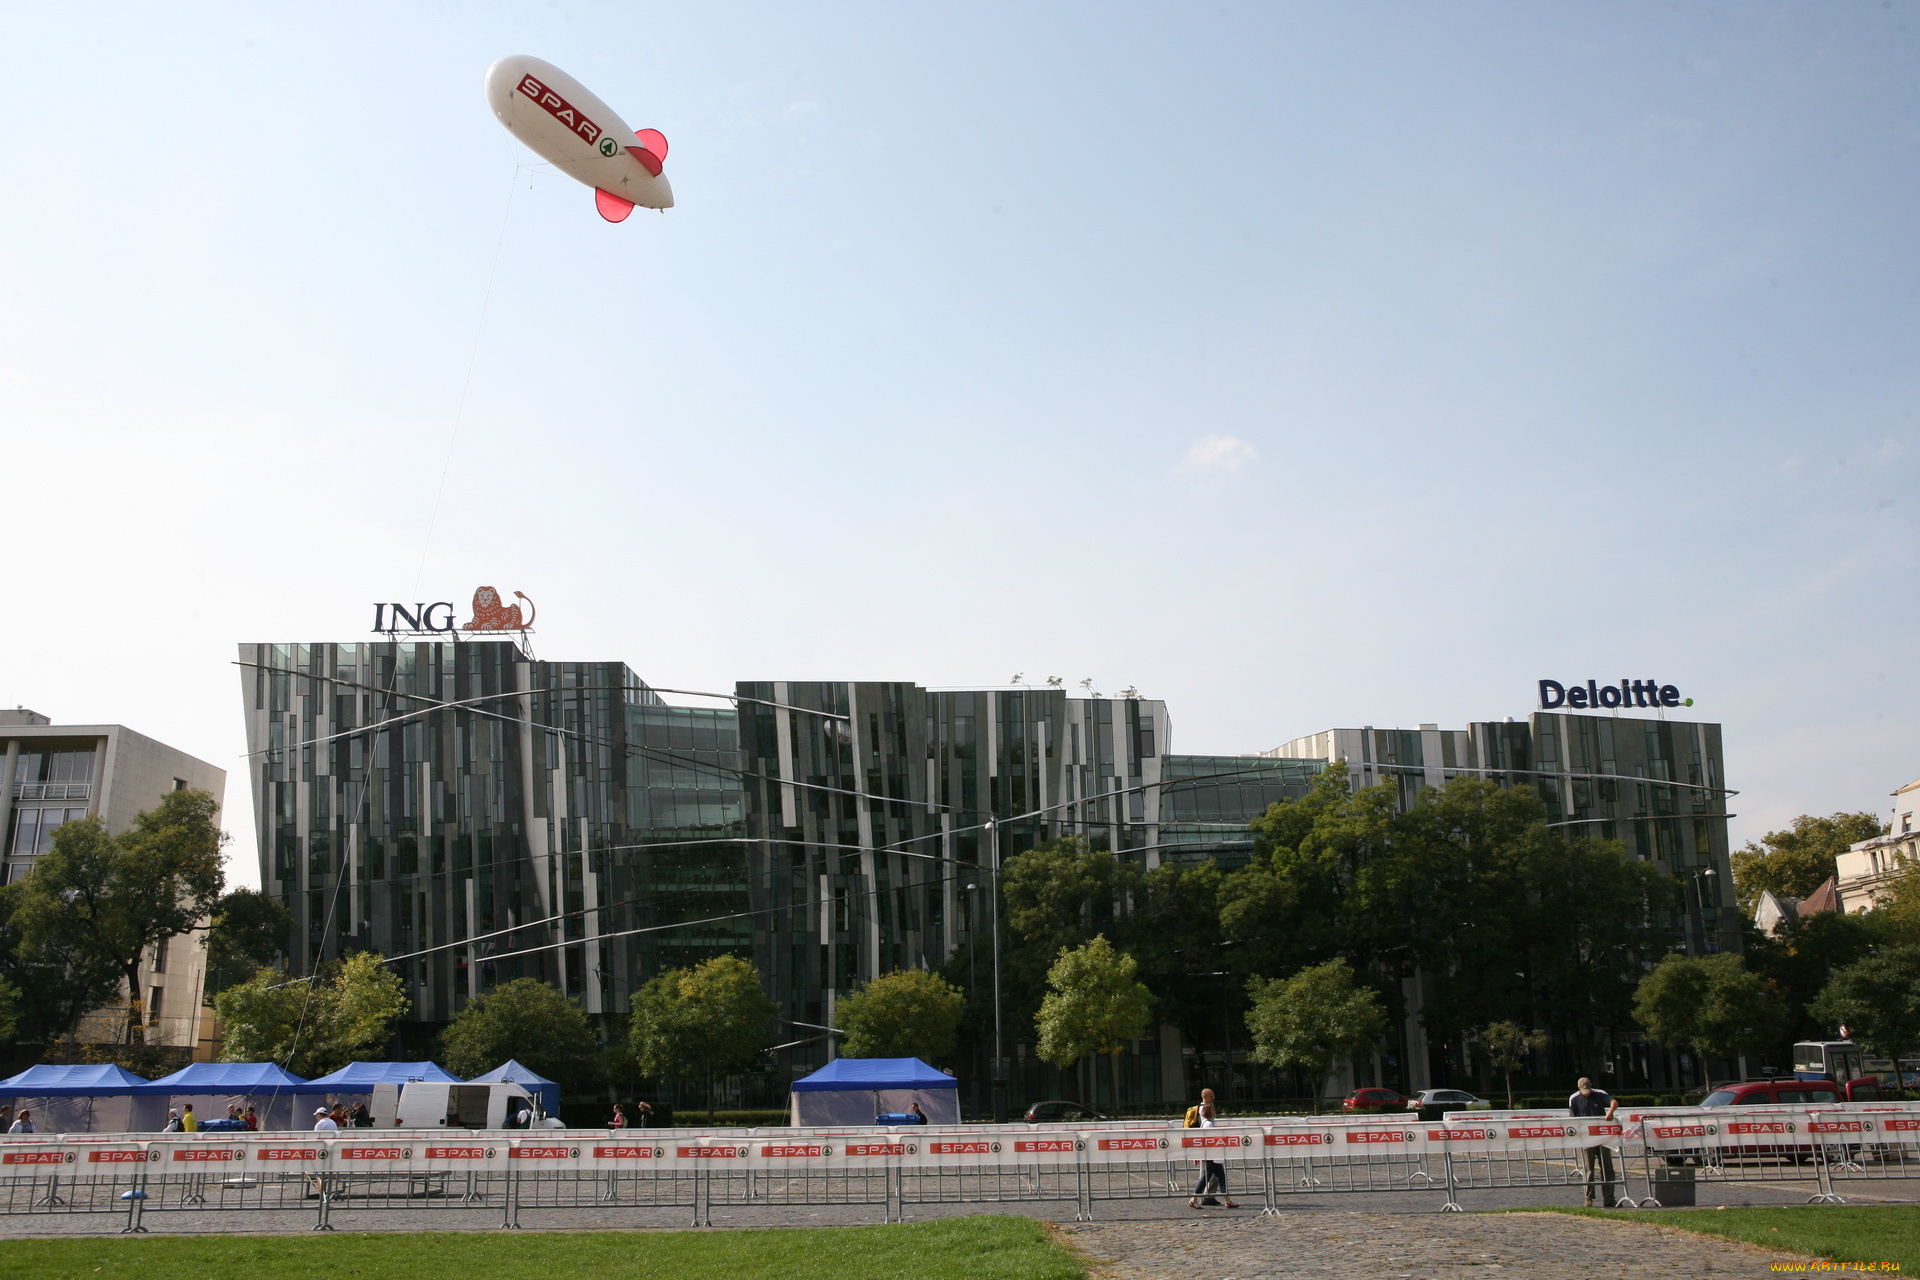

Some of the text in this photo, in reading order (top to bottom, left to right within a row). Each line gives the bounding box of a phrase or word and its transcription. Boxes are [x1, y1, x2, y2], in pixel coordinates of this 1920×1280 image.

[522, 78, 598, 142] SPAR
[370, 602, 456, 632] ING
[1738, 1124, 1784, 1133] SPAR
[1817, 1122, 1861, 1131] SPAR
[1896, 1121, 1920, 1130] SP
[1438, 1130, 1484, 1140] SPAR
[1519, 1128, 1564, 1137] SPAR
[1660, 1126, 1704, 1137] SPAR
[1193, 1137, 1240, 1147] SPAR
[1275, 1135, 1321, 1145] SPAR
[1357, 1132, 1402, 1142] SPAR
[941, 1143, 988, 1153] SPAR
[1025, 1141, 1072, 1152] SPAR
[1109, 1139, 1157, 1150] SPAR
[268, 1150, 315, 1159] SPAR
[352, 1149, 399, 1159] SPAR
[436, 1148, 483, 1158] SPAR
[520, 1148, 568, 1158] SPAR
[604, 1148, 651, 1157] SPAR
[688, 1148, 735, 1157] SPAR
[772, 1147, 820, 1156] SPAR
[857, 1145, 904, 1155] SPAR
[14, 1153, 63, 1163] SPAR
[100, 1152, 147, 1162] SPAR
[184, 1151, 232, 1160] SPAR
